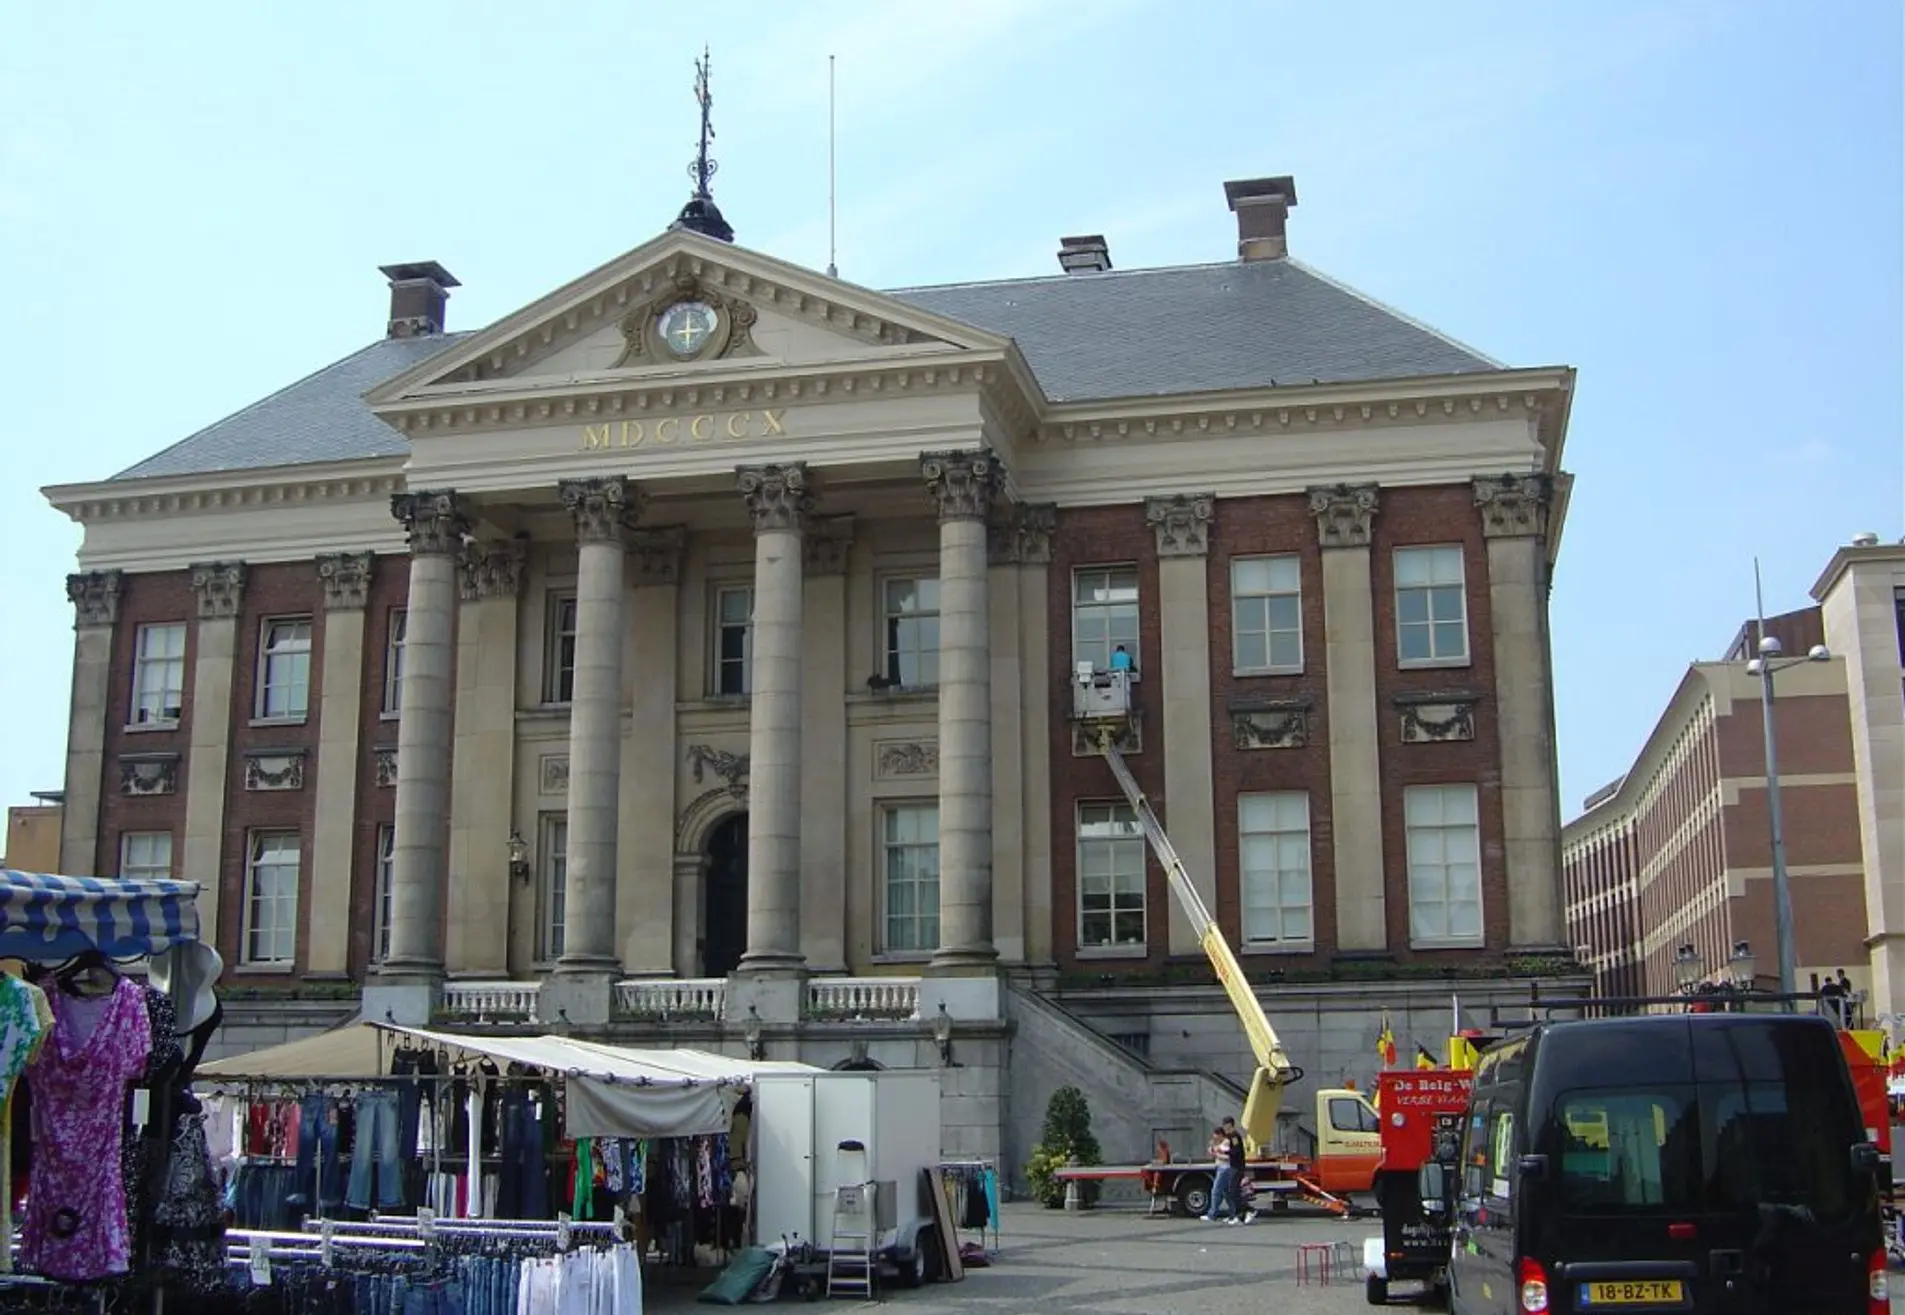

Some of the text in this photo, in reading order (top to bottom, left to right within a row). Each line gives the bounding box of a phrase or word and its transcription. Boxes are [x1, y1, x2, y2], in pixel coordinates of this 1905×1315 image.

[577, 408, 786, 451] MDCCCX
[1394, 1079, 1413, 1092] De
[1598, 1283, 1673, 1299] 18-BZ-TK
